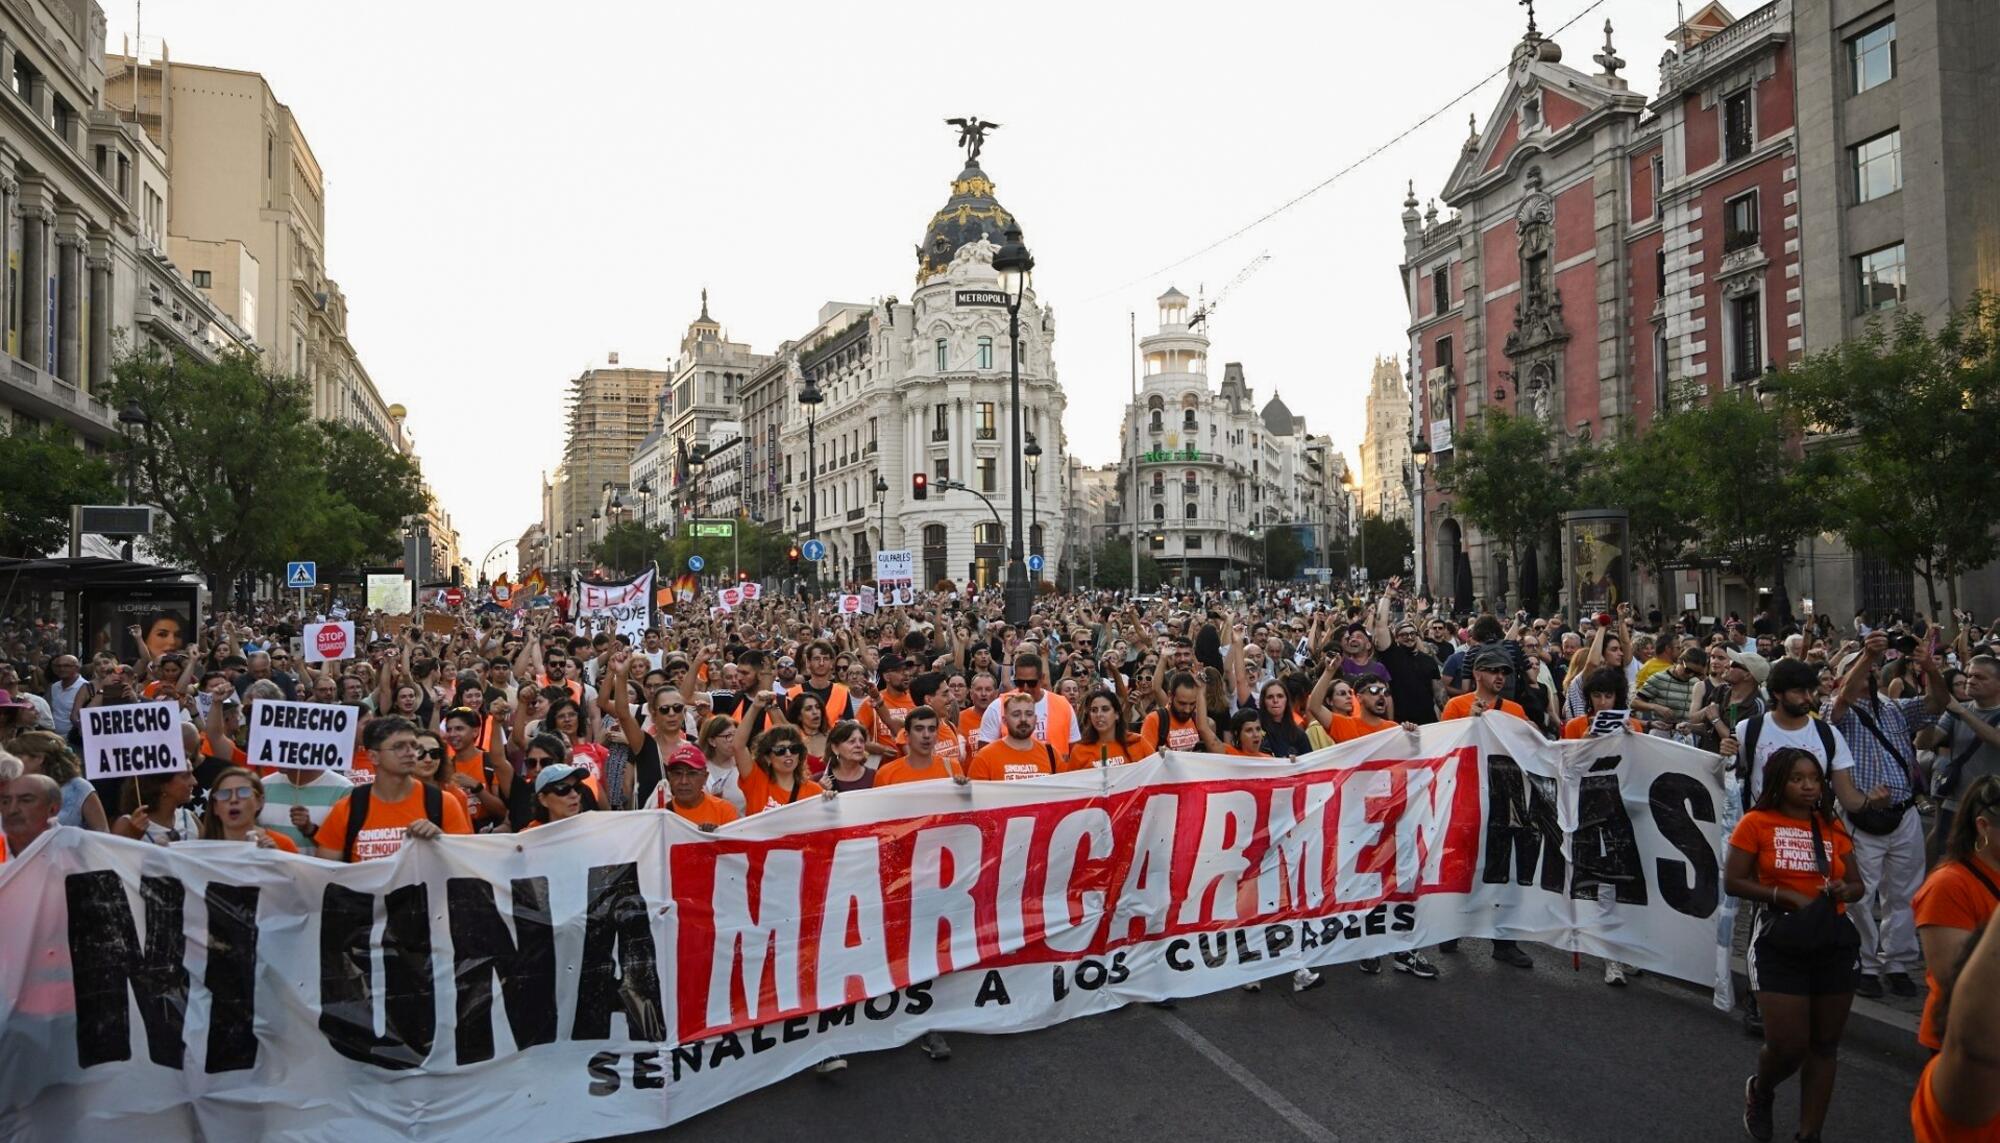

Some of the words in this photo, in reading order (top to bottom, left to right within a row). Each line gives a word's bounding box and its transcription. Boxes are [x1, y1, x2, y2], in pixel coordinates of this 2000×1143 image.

[958, 293, 1006, 304] METROPOLI
[587, 575, 649, 608] ELIX
[318, 631, 344, 643] STOP
[90, 706, 171, 736] DERECHO
[260, 704, 347, 733] DERECHO
[99, 748, 111, 773] A
[112, 743, 178, 772] TECHO.
[259, 738, 273, 762] A
[278, 742, 344, 767] TECHO.
[358, 827, 408, 841] SINDICAT
[1774, 827, 1813, 838] SINDICAT
[65, 869, 261, 1075] NI
[318, 861, 667, 1071] UNA
[705, 755, 1461, 1029] MARICARMEN
[1482, 754, 1720, 920] MÁS
[974, 969, 1011, 1008] A
[1053, 951, 1130, 1002] LOS
